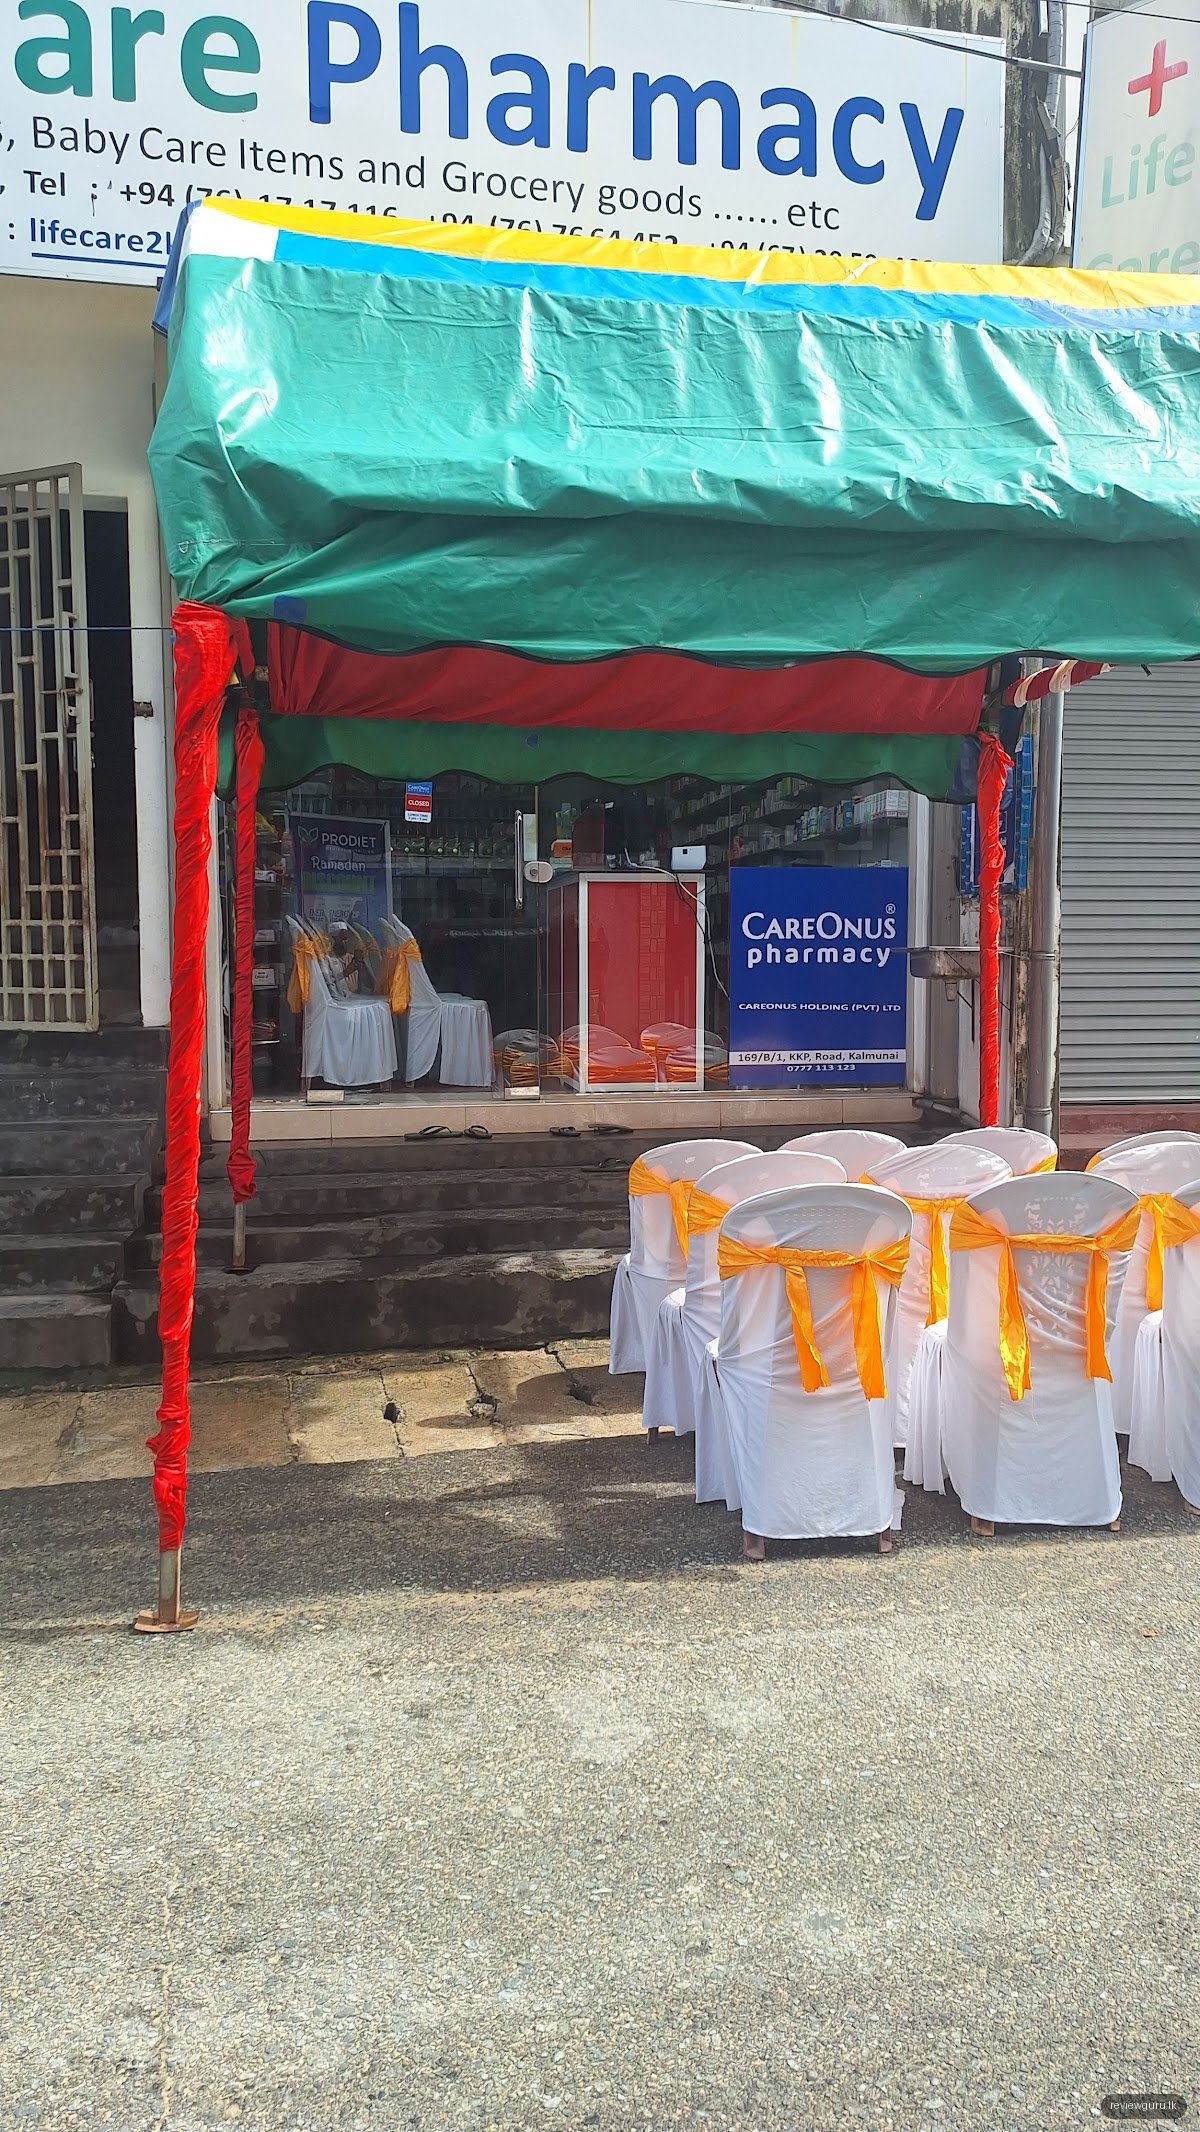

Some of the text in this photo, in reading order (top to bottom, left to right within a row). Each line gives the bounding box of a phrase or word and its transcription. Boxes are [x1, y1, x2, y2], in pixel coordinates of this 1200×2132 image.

[306, 1, 965, 221] Pharmacy
[32, 116, 130, 165] Baby
[139, 127, 227, 168] Care
[239, 137, 344, 181] Items
[358, 156, 426, 190] and
[442, 161, 585, 212] Grocery
[598, 184, 703, 217] goods
[787, 202, 840, 230] etc
[1101, 133, 1196, 209] Life
[23, 170, 66, 197] Tel
[119, 181, 175, 207] +94
[407, 799, 430, 807] CLOSED
[321, 833, 377, 848] PRODIET
[310, 855, 366, 872] Ramadan
[747, 943, 891, 968] pharmacy
[800, 1003, 849, 1011] HOLDING
[851, 1003, 880, 1012] (PVT)
[882, 1004, 901, 1012] LTD
[738, 1051, 899, 1063] 169/B/1, KKP, Road, Kalmunai
